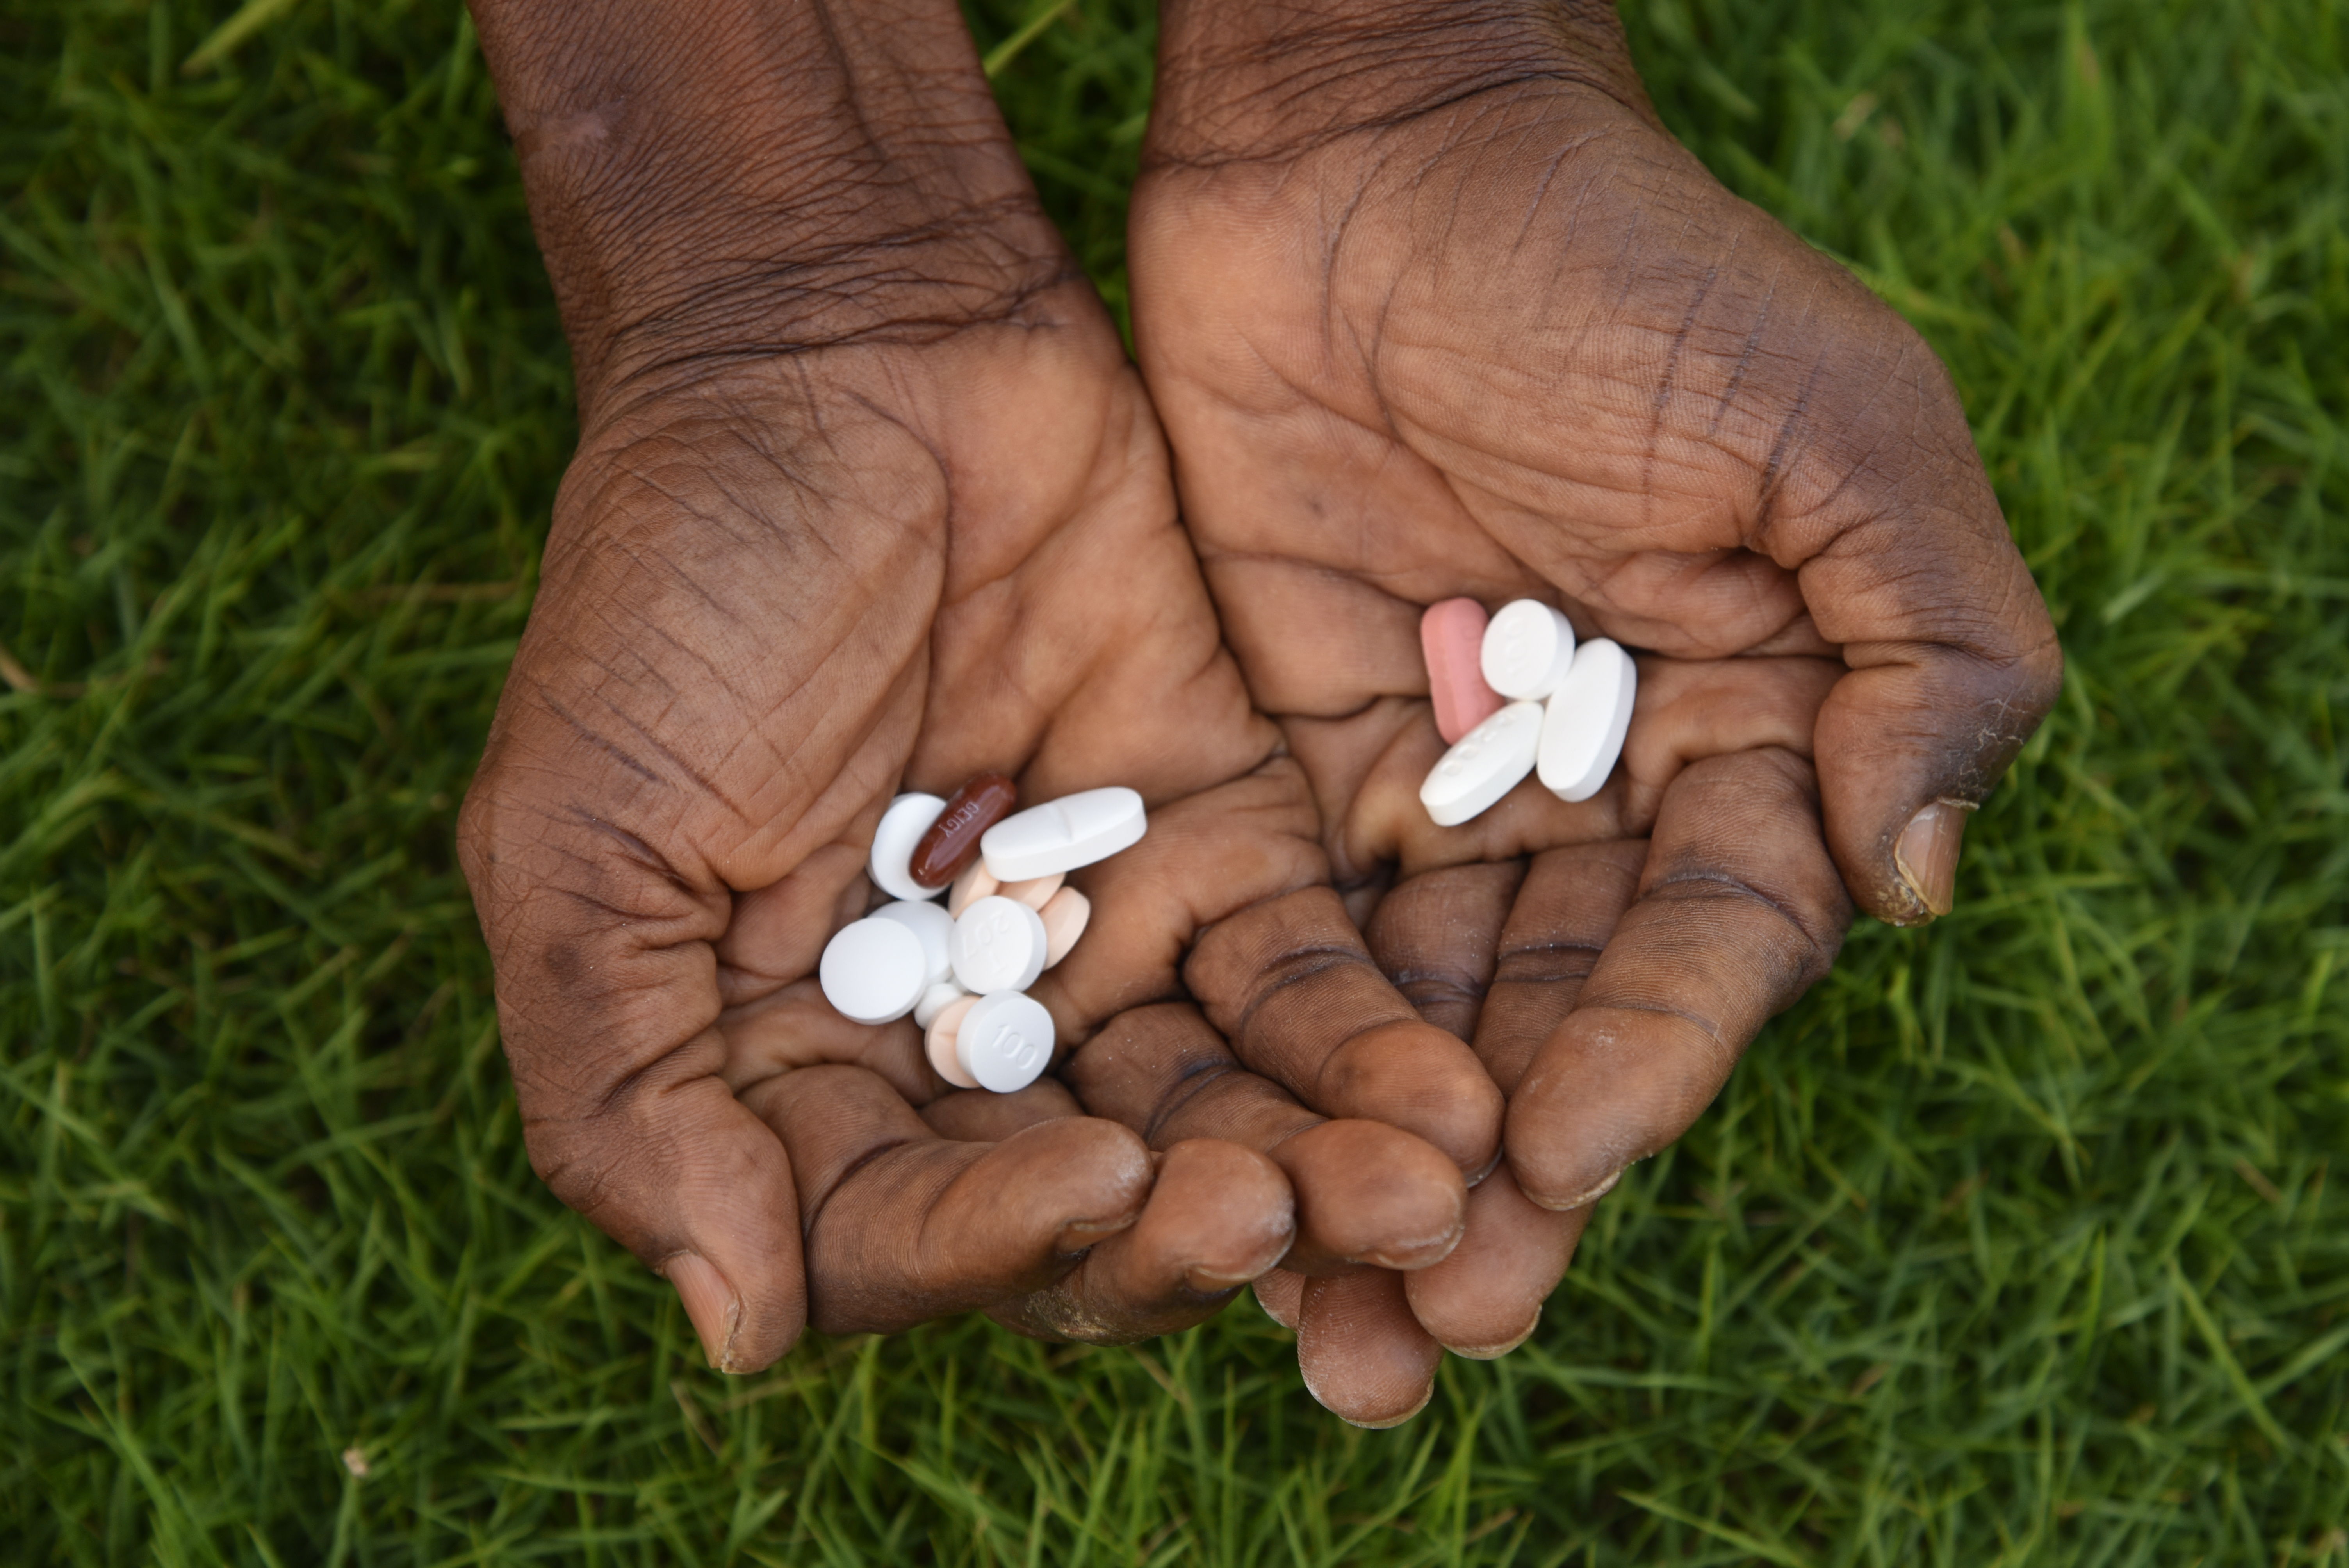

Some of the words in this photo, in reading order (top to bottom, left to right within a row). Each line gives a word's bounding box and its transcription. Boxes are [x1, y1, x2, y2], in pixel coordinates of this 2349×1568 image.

[938, 800, 980, 839] GEIGY
[962, 910, 1010, 959] 207
[992, 1023, 1038, 1070] 100
